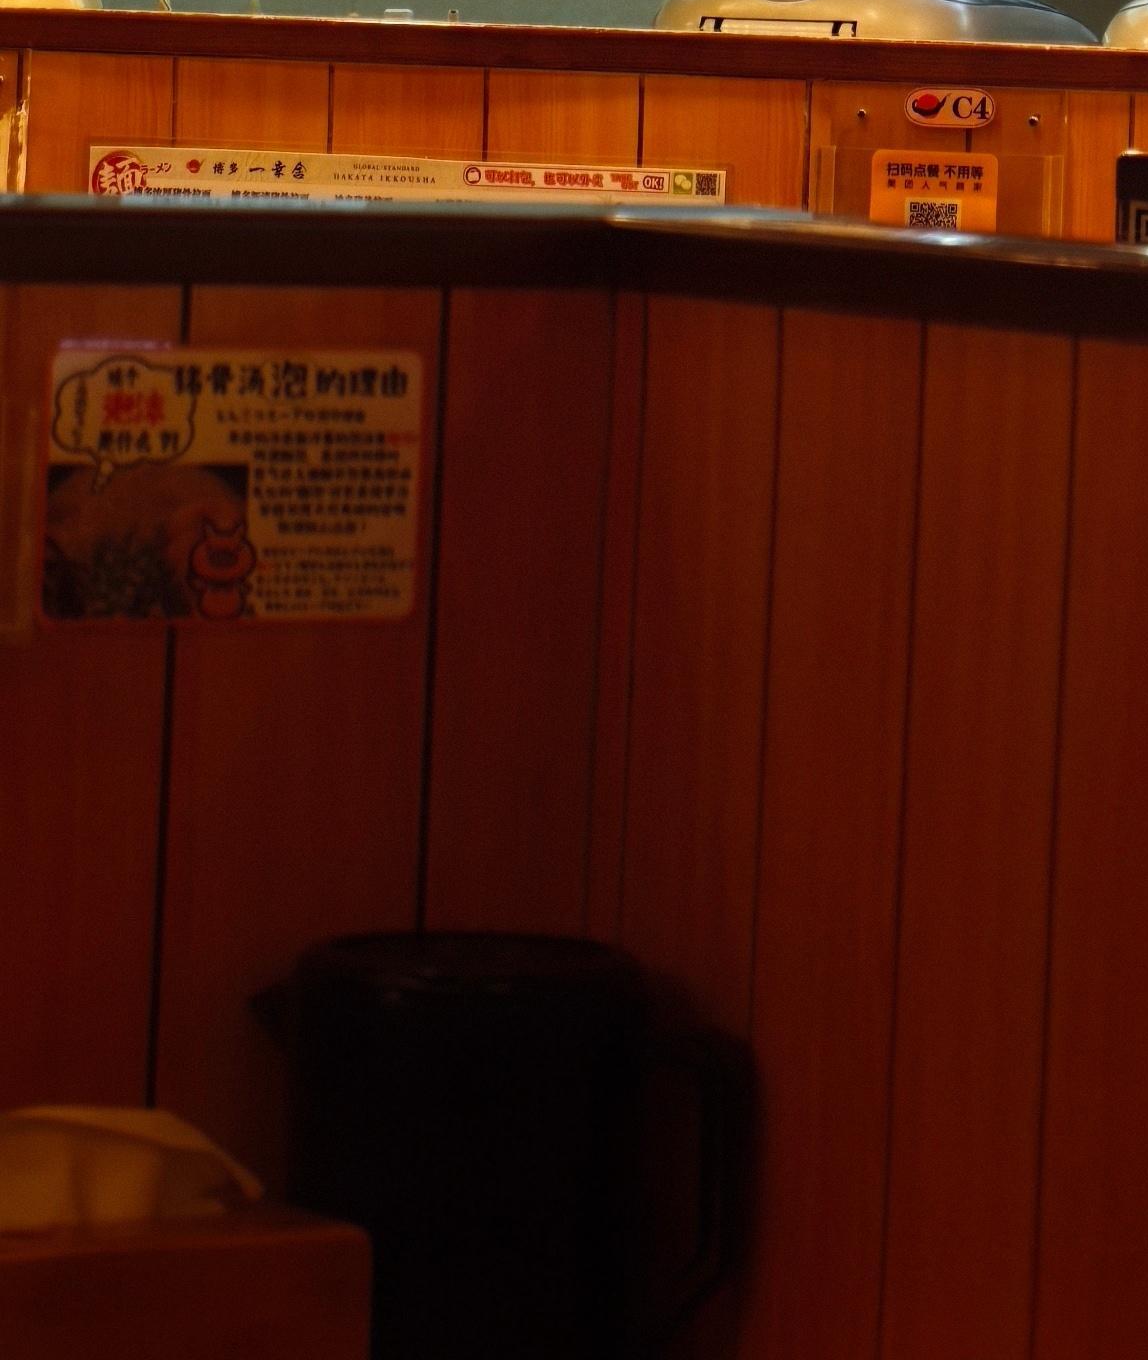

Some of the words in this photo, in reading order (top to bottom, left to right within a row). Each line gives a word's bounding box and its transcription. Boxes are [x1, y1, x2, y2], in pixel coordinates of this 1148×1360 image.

[952, 96, 990, 120] C4
[212, 161, 240, 176] 博多
[887, 162, 940, 179] 扫码点餐
[943, 165, 984, 181] 不用等
[333, 173, 373, 182] HAKATA
[379, 174, 437, 184] IKKOUSHA
